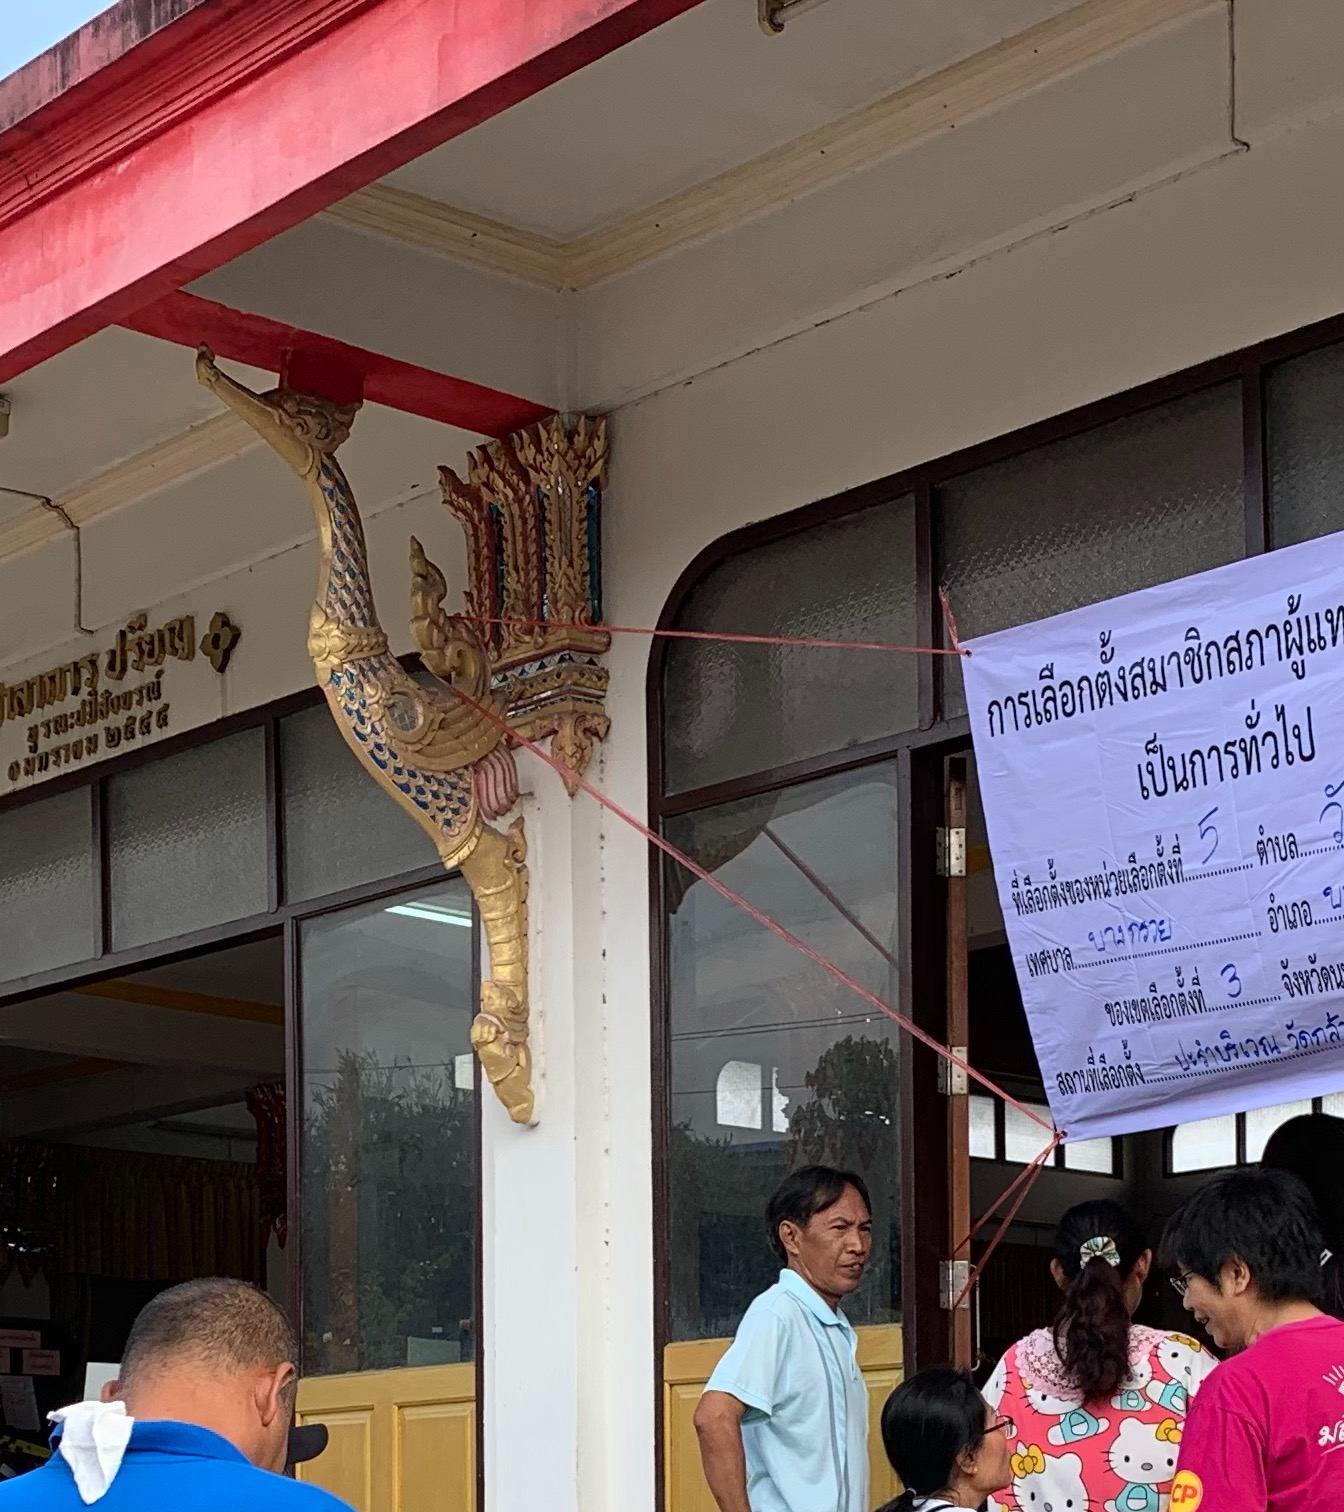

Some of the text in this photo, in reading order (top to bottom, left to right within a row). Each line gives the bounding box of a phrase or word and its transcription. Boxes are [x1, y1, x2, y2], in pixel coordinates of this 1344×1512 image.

[1137, 699, 1316, 800] เป็นการทั่วไป
[1011, 833, 1185, 917] ที่เลือกตั้งของหน่วยเลือกตั้งที่
[1197, 806, 1219, 865] 5
[1256, 824, 1300, 866] ตำบล
[1025, 946, 1074, 977] เทศบาล
[1267, 892, 1314, 933] อำเภอ
[1104, 965, 1207, 1027] ของเขตเลือกตั้งที่
[1220, 963, 1242, 999] 3
[1055, 1038, 1147, 1097] สถานที่เลือกตั้ง
[1171, 1483, 1198, 1504] CP
